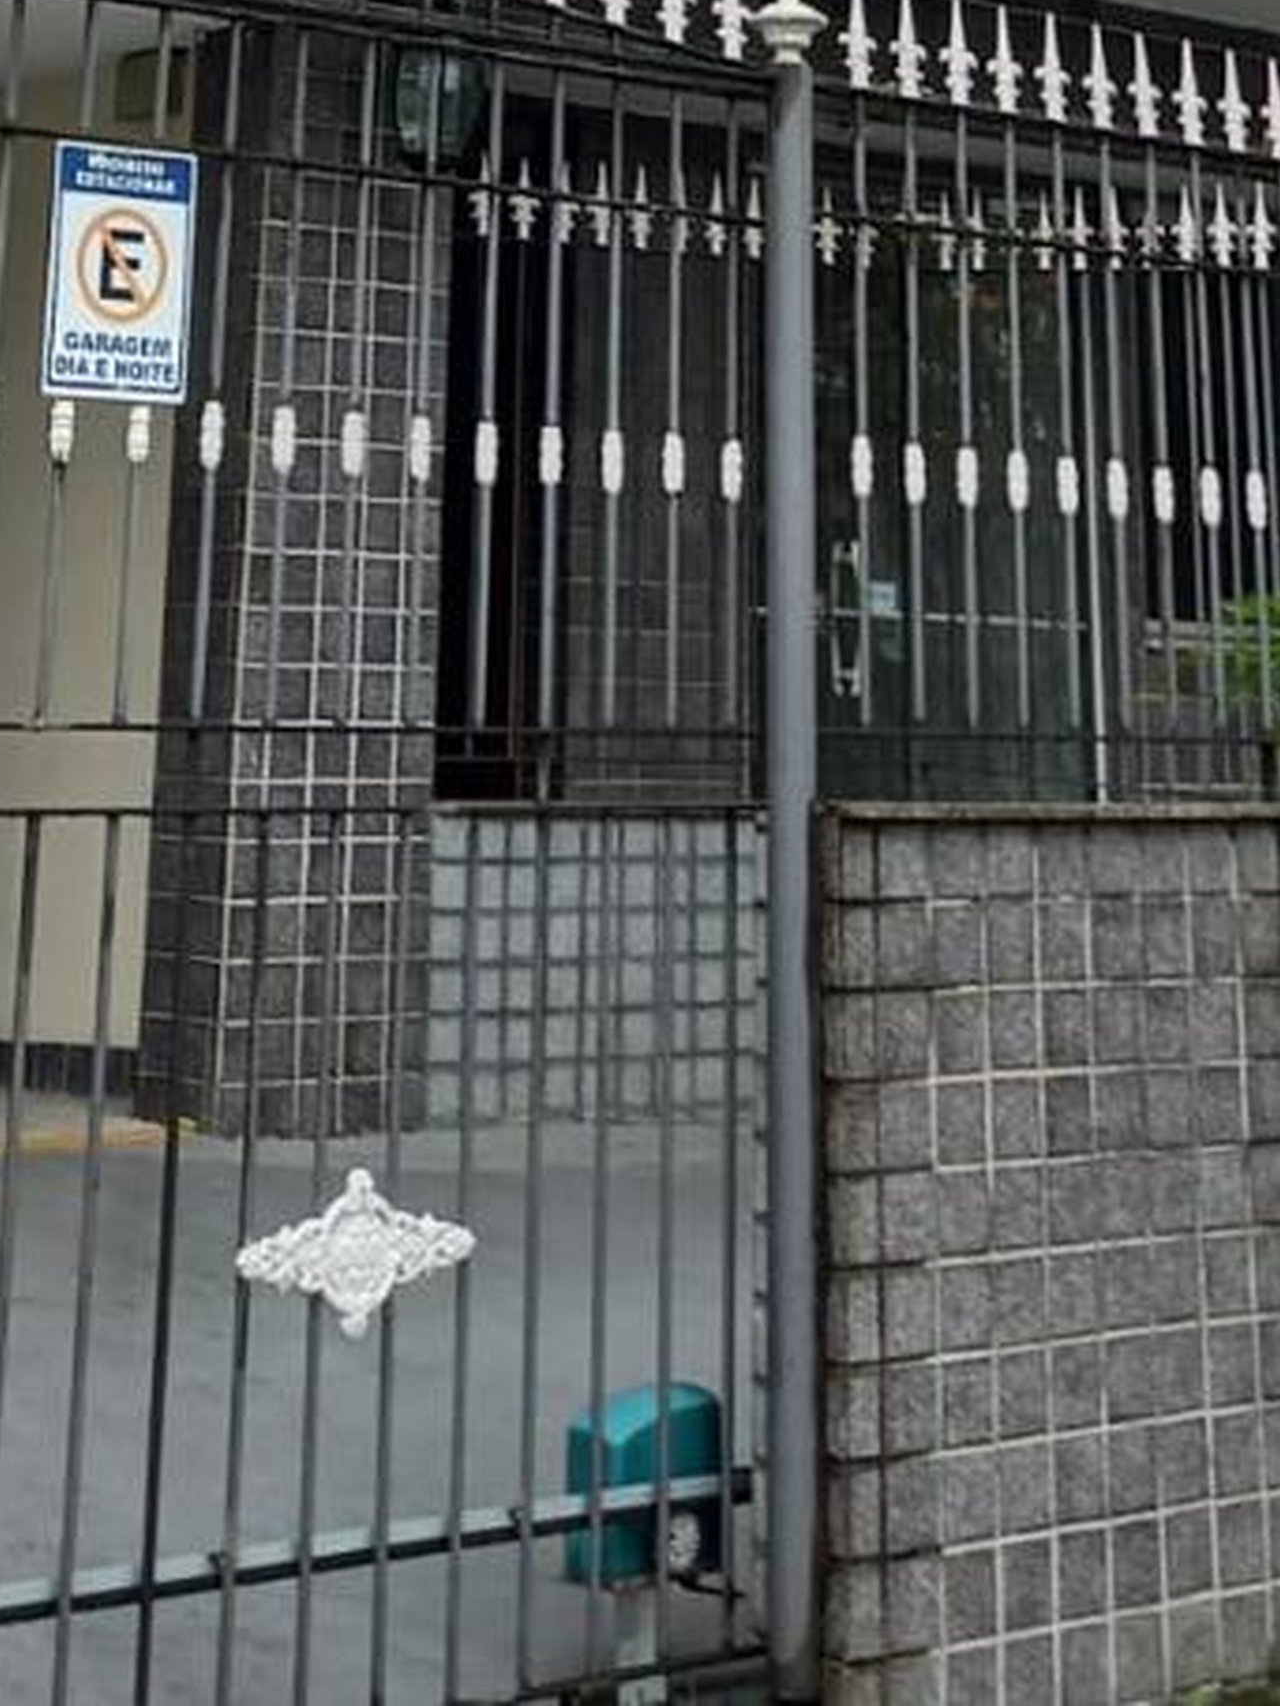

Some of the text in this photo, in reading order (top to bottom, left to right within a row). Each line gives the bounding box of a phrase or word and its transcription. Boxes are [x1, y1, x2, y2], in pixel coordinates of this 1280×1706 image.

[64, 332, 173, 358] GARAGEM
[55, 355, 175, 383] DIA E NOITE
